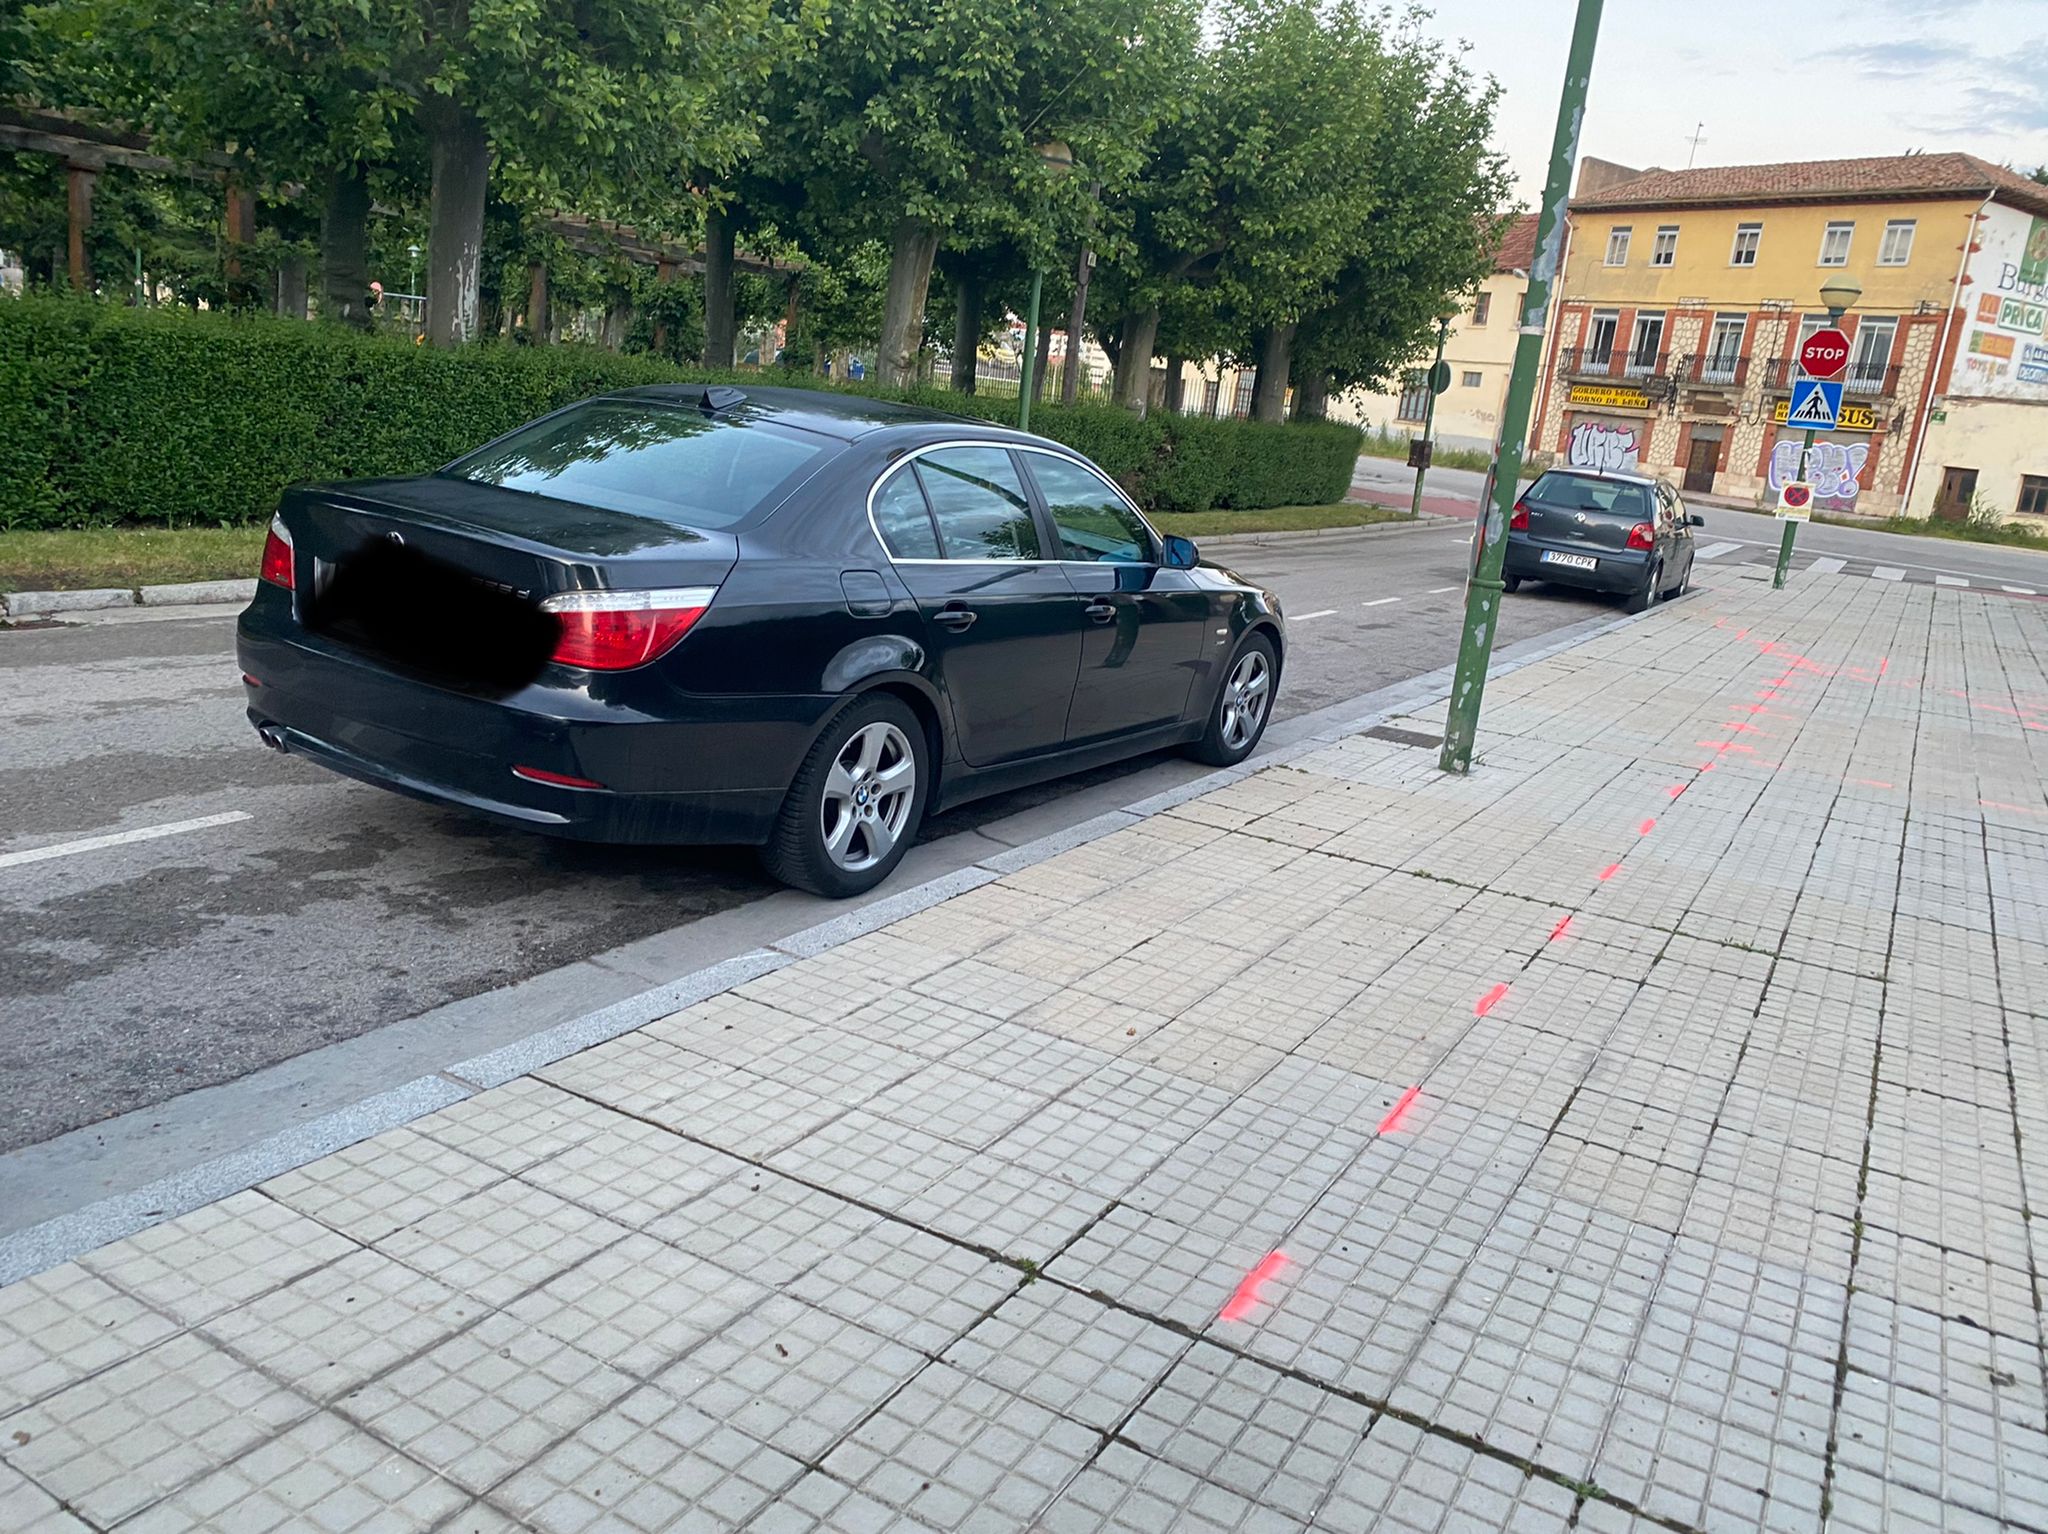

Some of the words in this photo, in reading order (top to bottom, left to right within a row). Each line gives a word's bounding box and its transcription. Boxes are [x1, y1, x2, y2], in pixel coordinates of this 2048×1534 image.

[2001, 303, 2042, 330] PRYCA
[1805, 347, 1845, 360] STOP
[1572, 395, 1602, 403] HORNO
[1606, 397, 1618, 405] DE
[1549, 552, 1573, 564] 3770
[1575, 556, 1594, 567] CPK
